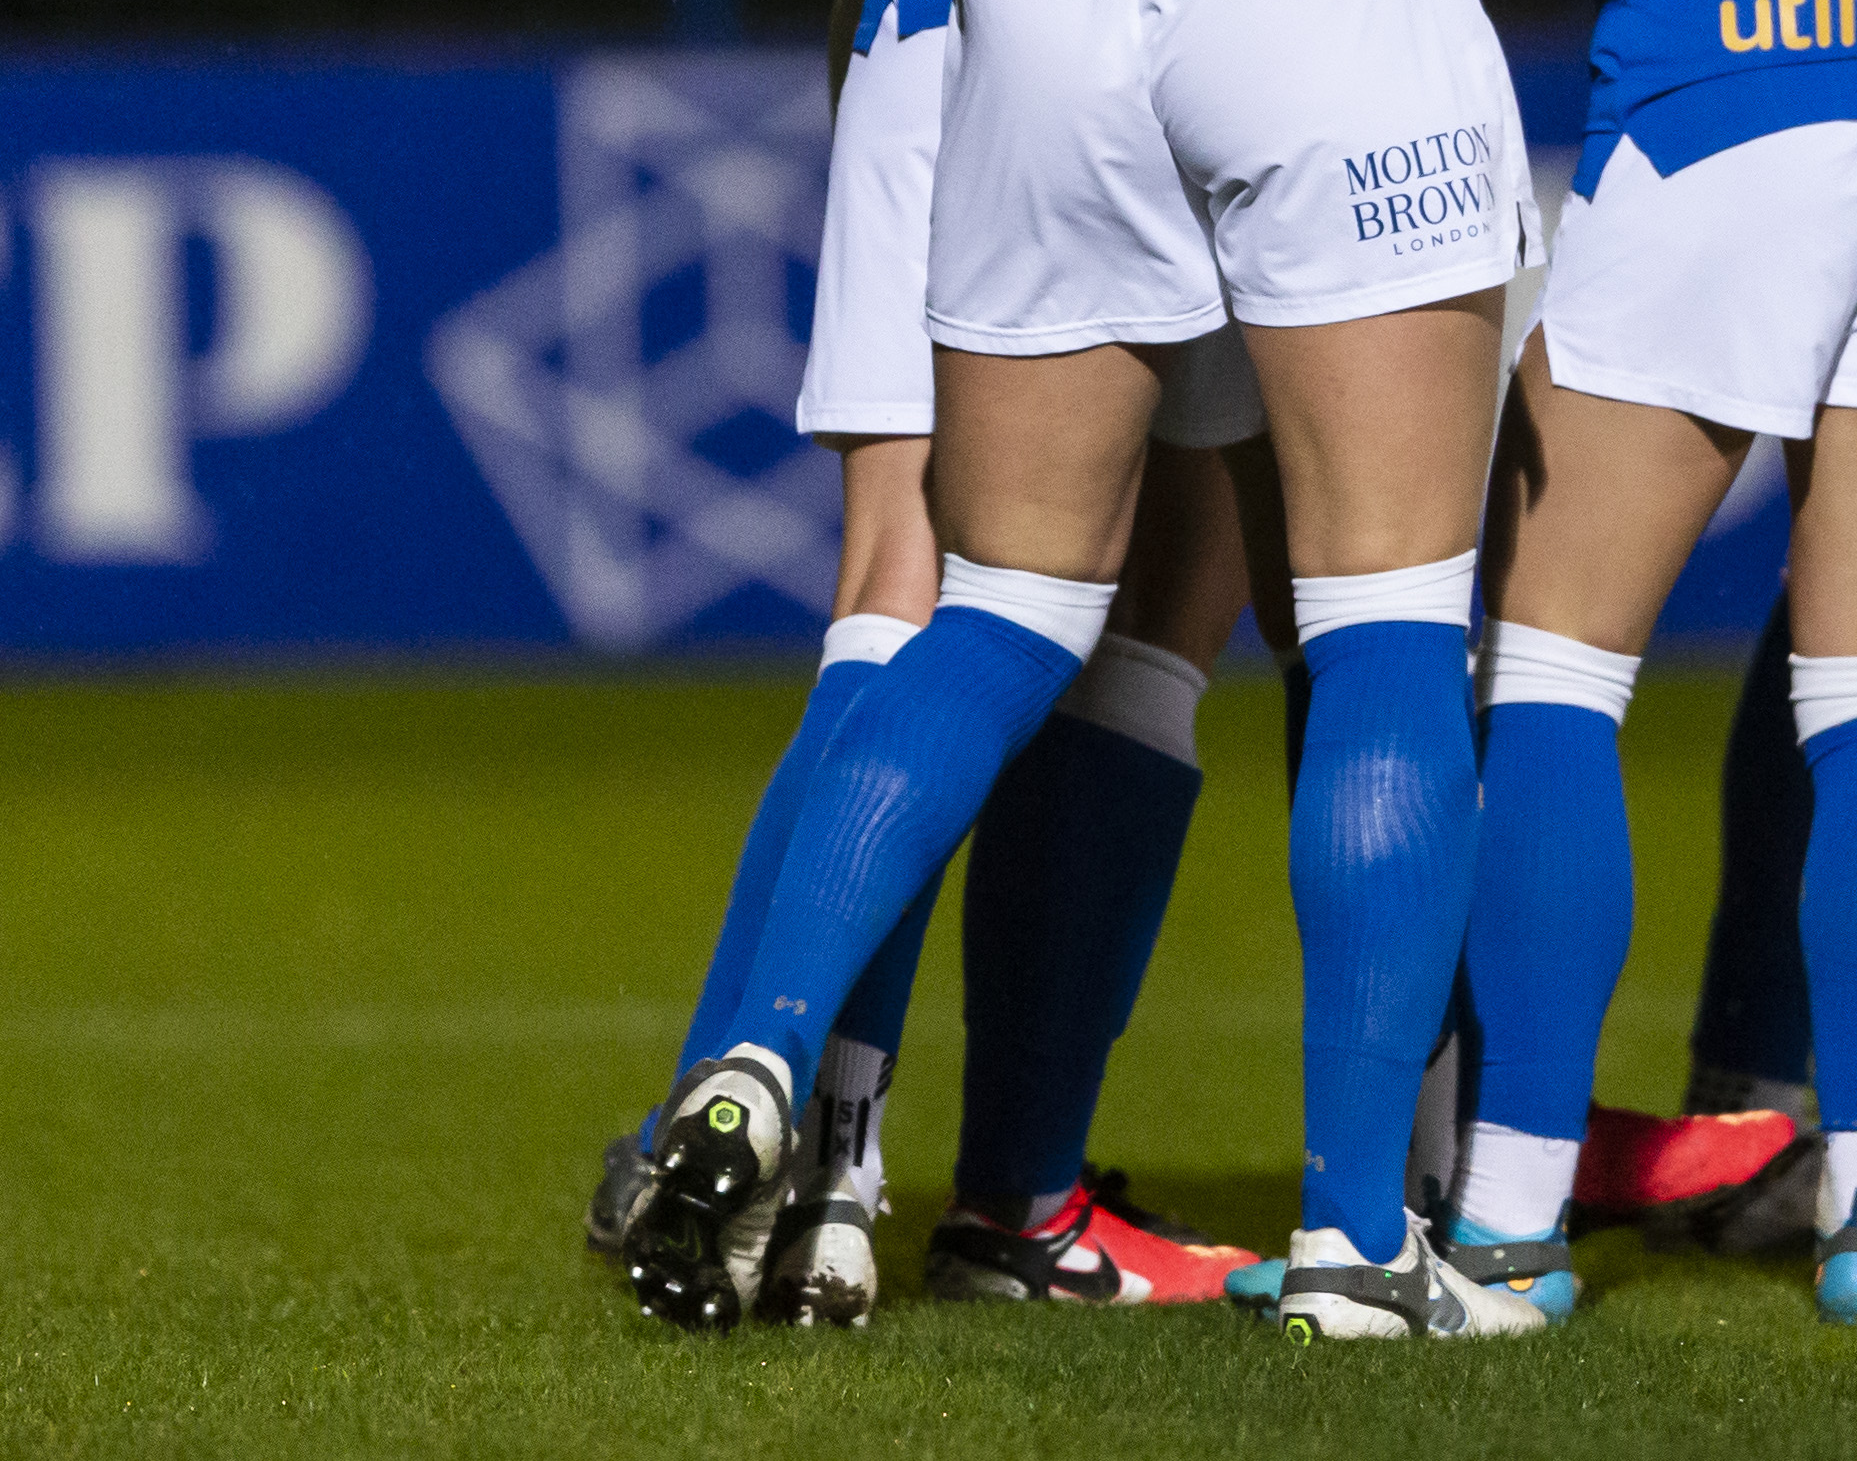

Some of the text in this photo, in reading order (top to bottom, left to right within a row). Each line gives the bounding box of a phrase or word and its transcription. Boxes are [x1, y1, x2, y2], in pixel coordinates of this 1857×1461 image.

[1341, 122, 1492, 197] MOLTON
[1350, 172, 1496, 243] BROWN
[1392, 221, 1492, 257] LONDON
[0, 153, 380, 566] P
